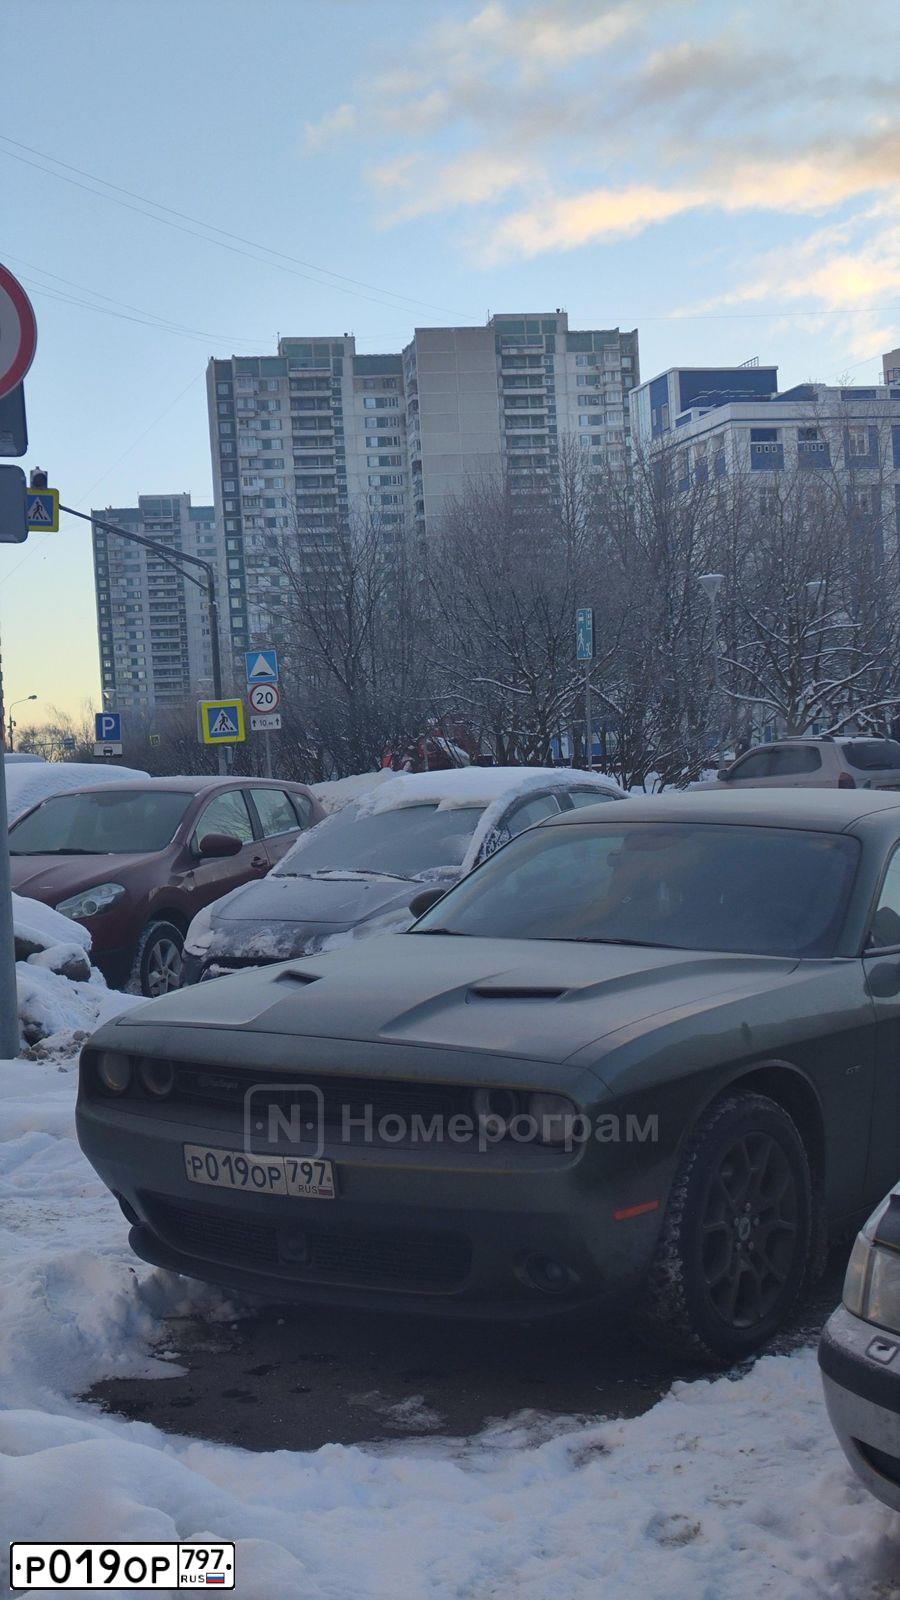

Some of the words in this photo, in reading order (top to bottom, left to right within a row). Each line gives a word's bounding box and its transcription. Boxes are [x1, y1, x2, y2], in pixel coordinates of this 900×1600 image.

[256, 691, 274, 705] 20
[102, 716, 115, 738] P
[259, 719, 267, 727] 10
[191, 1152, 282, 1189] Р019ОР
[286, 1159, 326, 1185] 797
[298, 1184, 318, 1194] RUS
